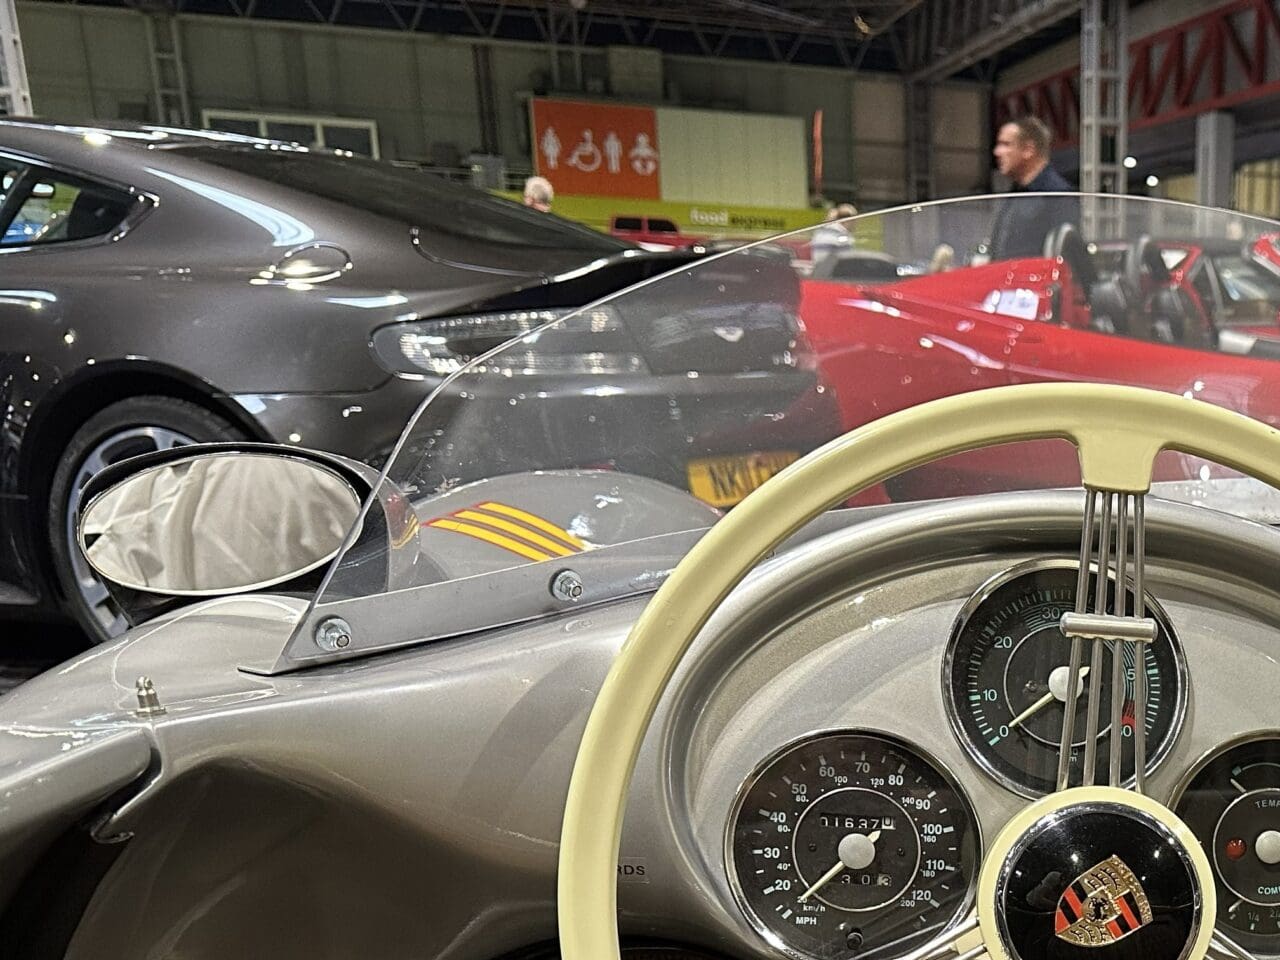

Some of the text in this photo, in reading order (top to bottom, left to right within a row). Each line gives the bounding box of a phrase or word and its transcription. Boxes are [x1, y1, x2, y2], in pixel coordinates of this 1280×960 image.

[690, 208, 728, 225] food
[1042, 606, 1059, 619] 30
[994, 636, 1013, 648] 20
[983, 689, 998, 701] 10
[1000, 725, 1009, 737] 0
[819, 767, 835, 777] 60
[855, 762, 870, 773] 70
[888, 775, 904, 785] 80
[791, 784, 807, 794] 50
[916, 799, 930, 810] 90
[770, 812, 786, 822] 40
[922, 824, 942, 834] 100
[764, 848, 779, 858] 30
[926, 860, 945, 870] 110
[775, 880, 790, 890] 20
[912, 890, 931, 900] 120
[796, 917, 817, 925] MPH
